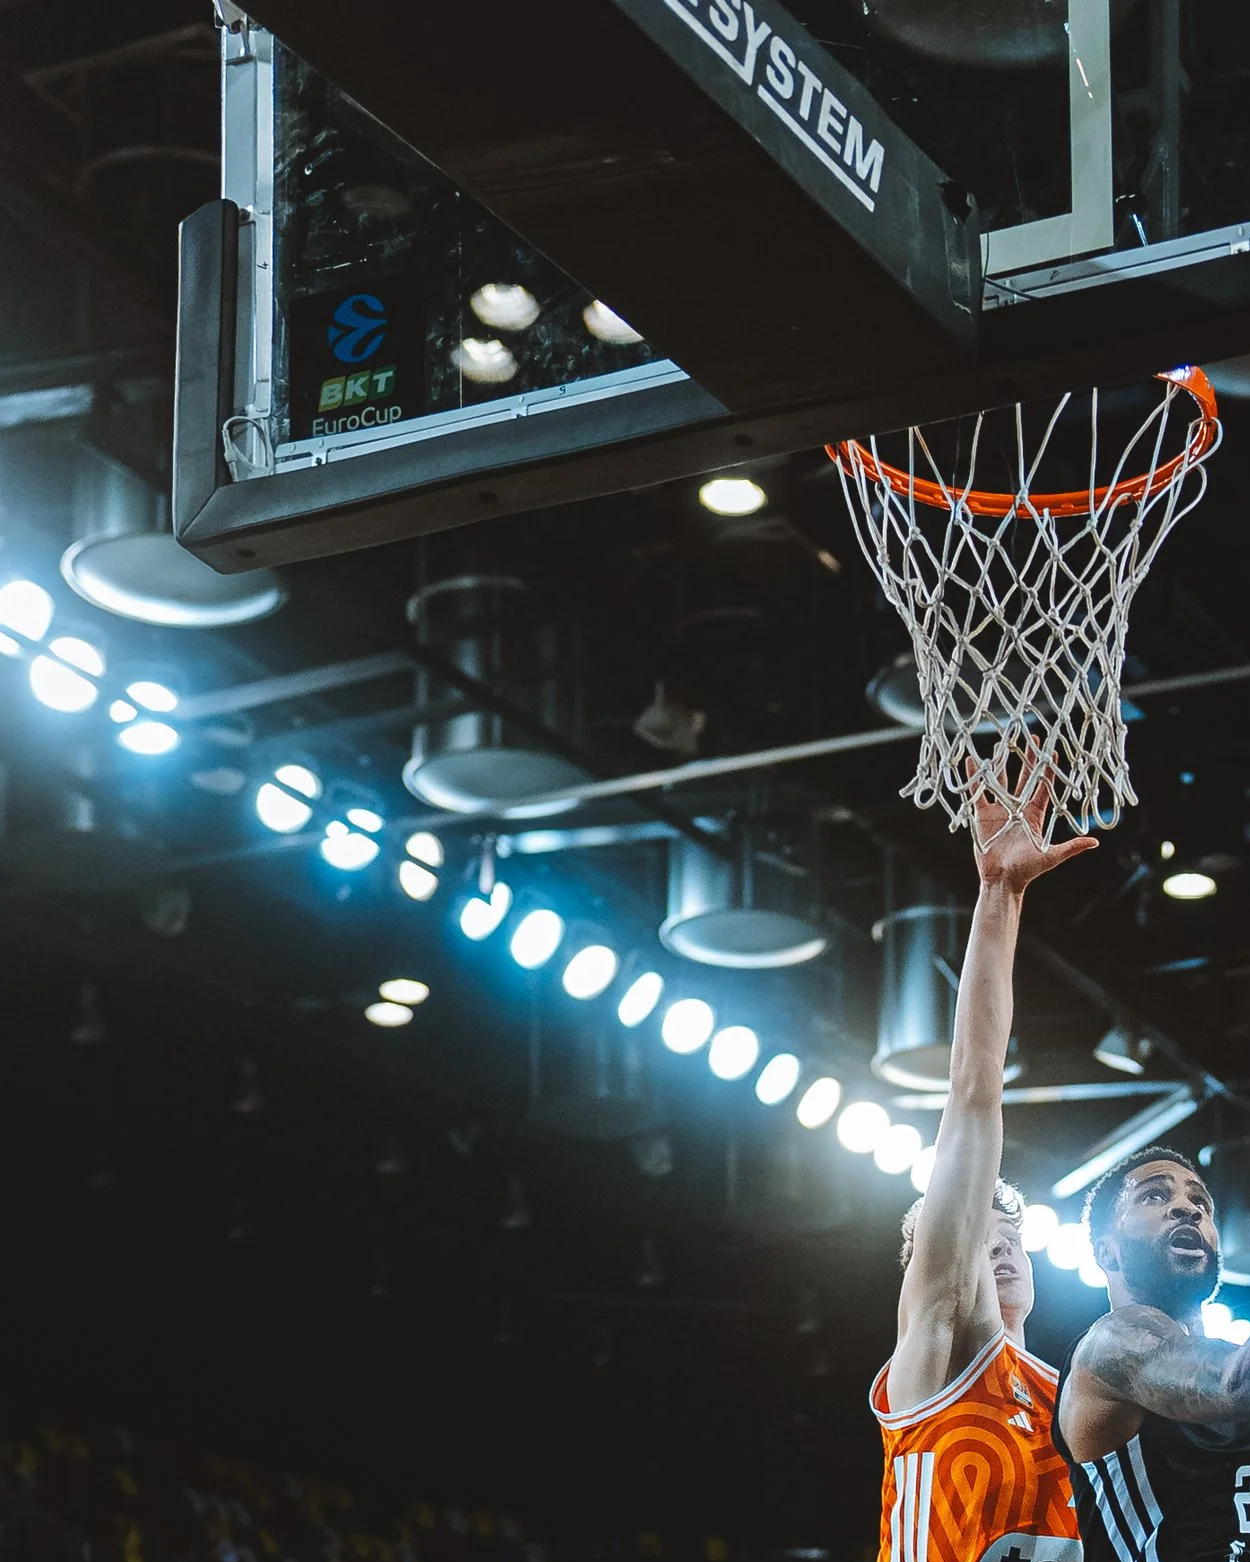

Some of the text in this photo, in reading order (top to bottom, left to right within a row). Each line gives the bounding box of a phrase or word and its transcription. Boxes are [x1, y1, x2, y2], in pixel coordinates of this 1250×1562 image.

[688, 0, 885, 194] SYSTEM
[321, 371, 395, 405] BKT
[312, 405, 402, 437] EuroCup
